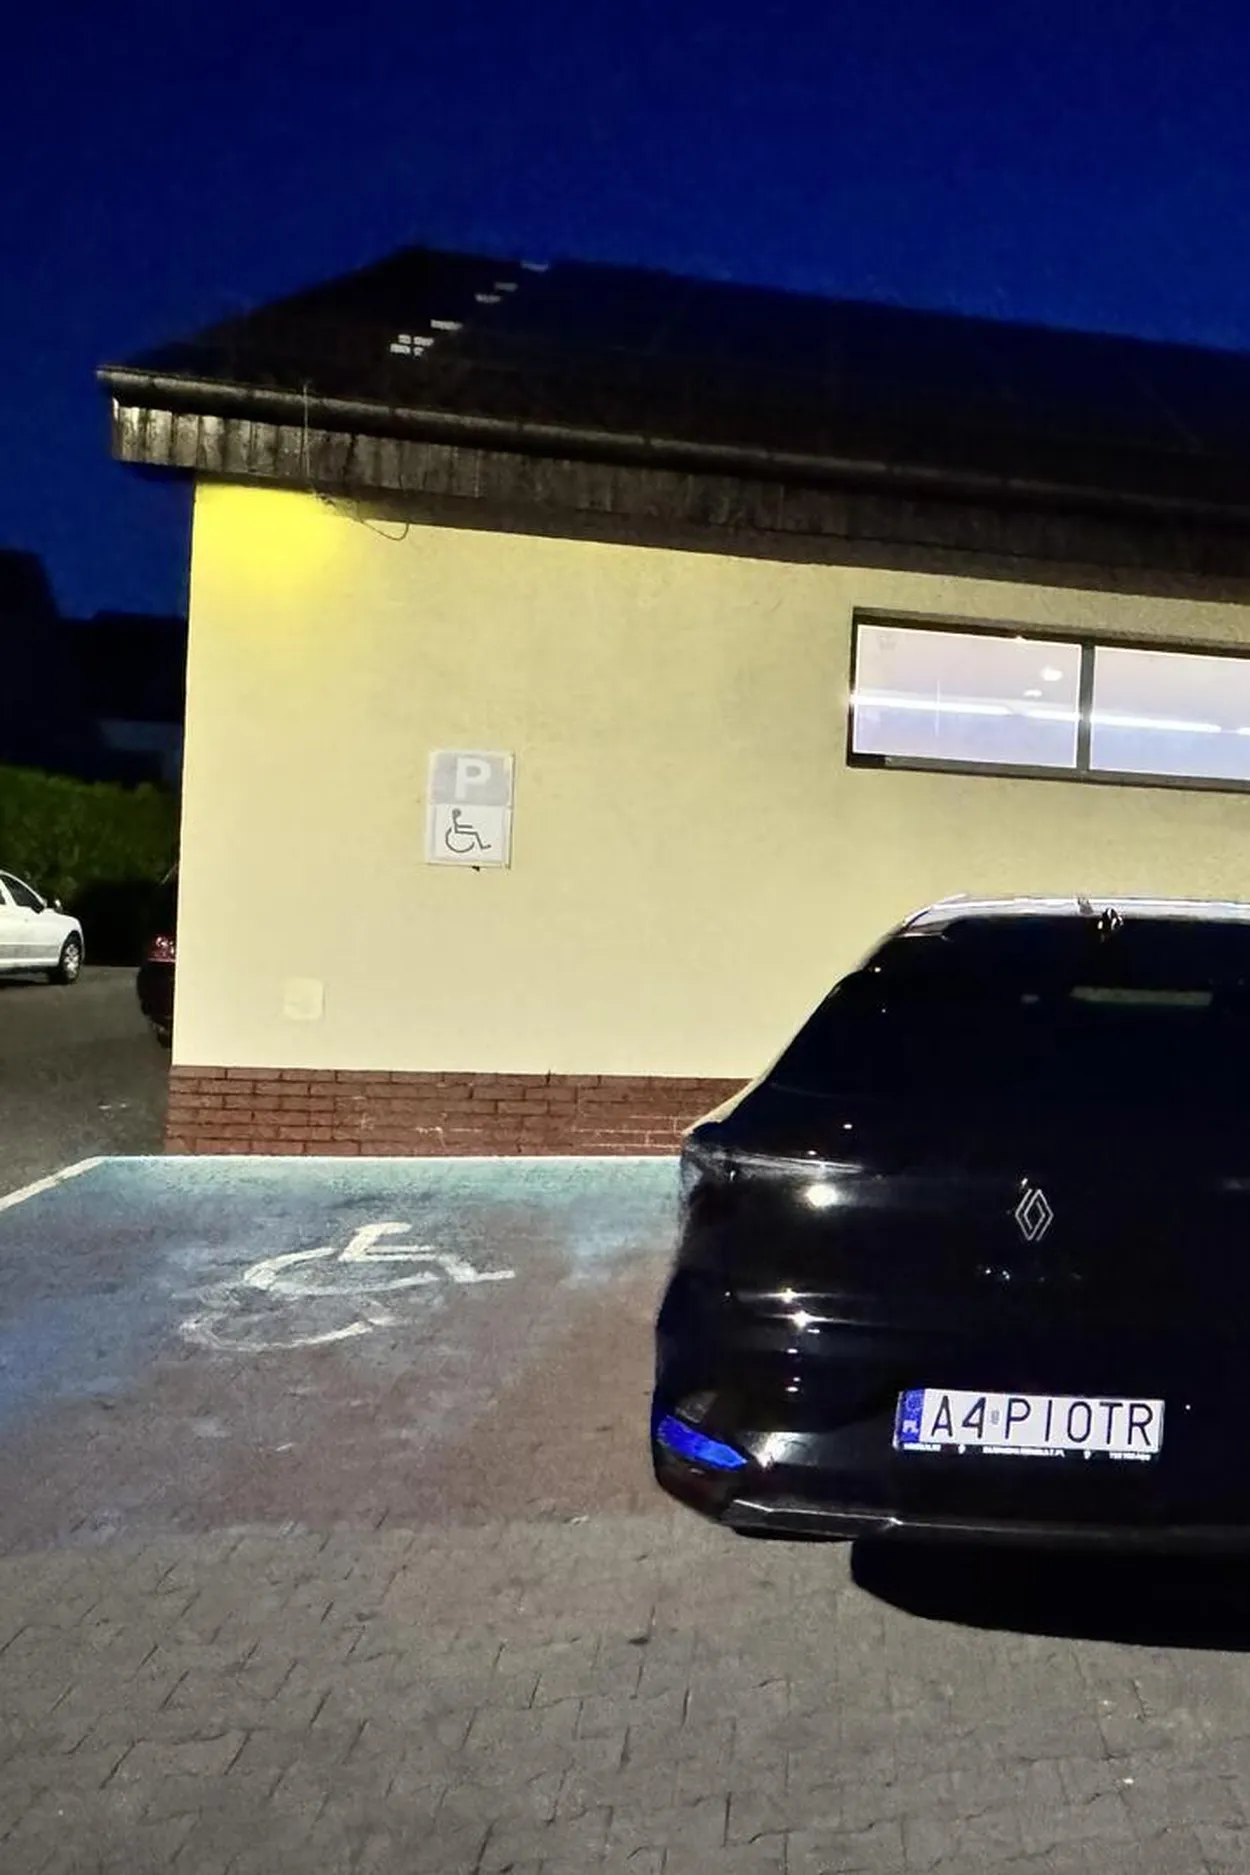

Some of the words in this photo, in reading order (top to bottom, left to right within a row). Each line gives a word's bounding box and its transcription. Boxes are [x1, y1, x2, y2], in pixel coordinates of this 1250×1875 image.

[454, 757, 491, 801] P
[931, 1395, 987, 1439] A4
[1004, 1397, 1155, 1446] PIOTR
